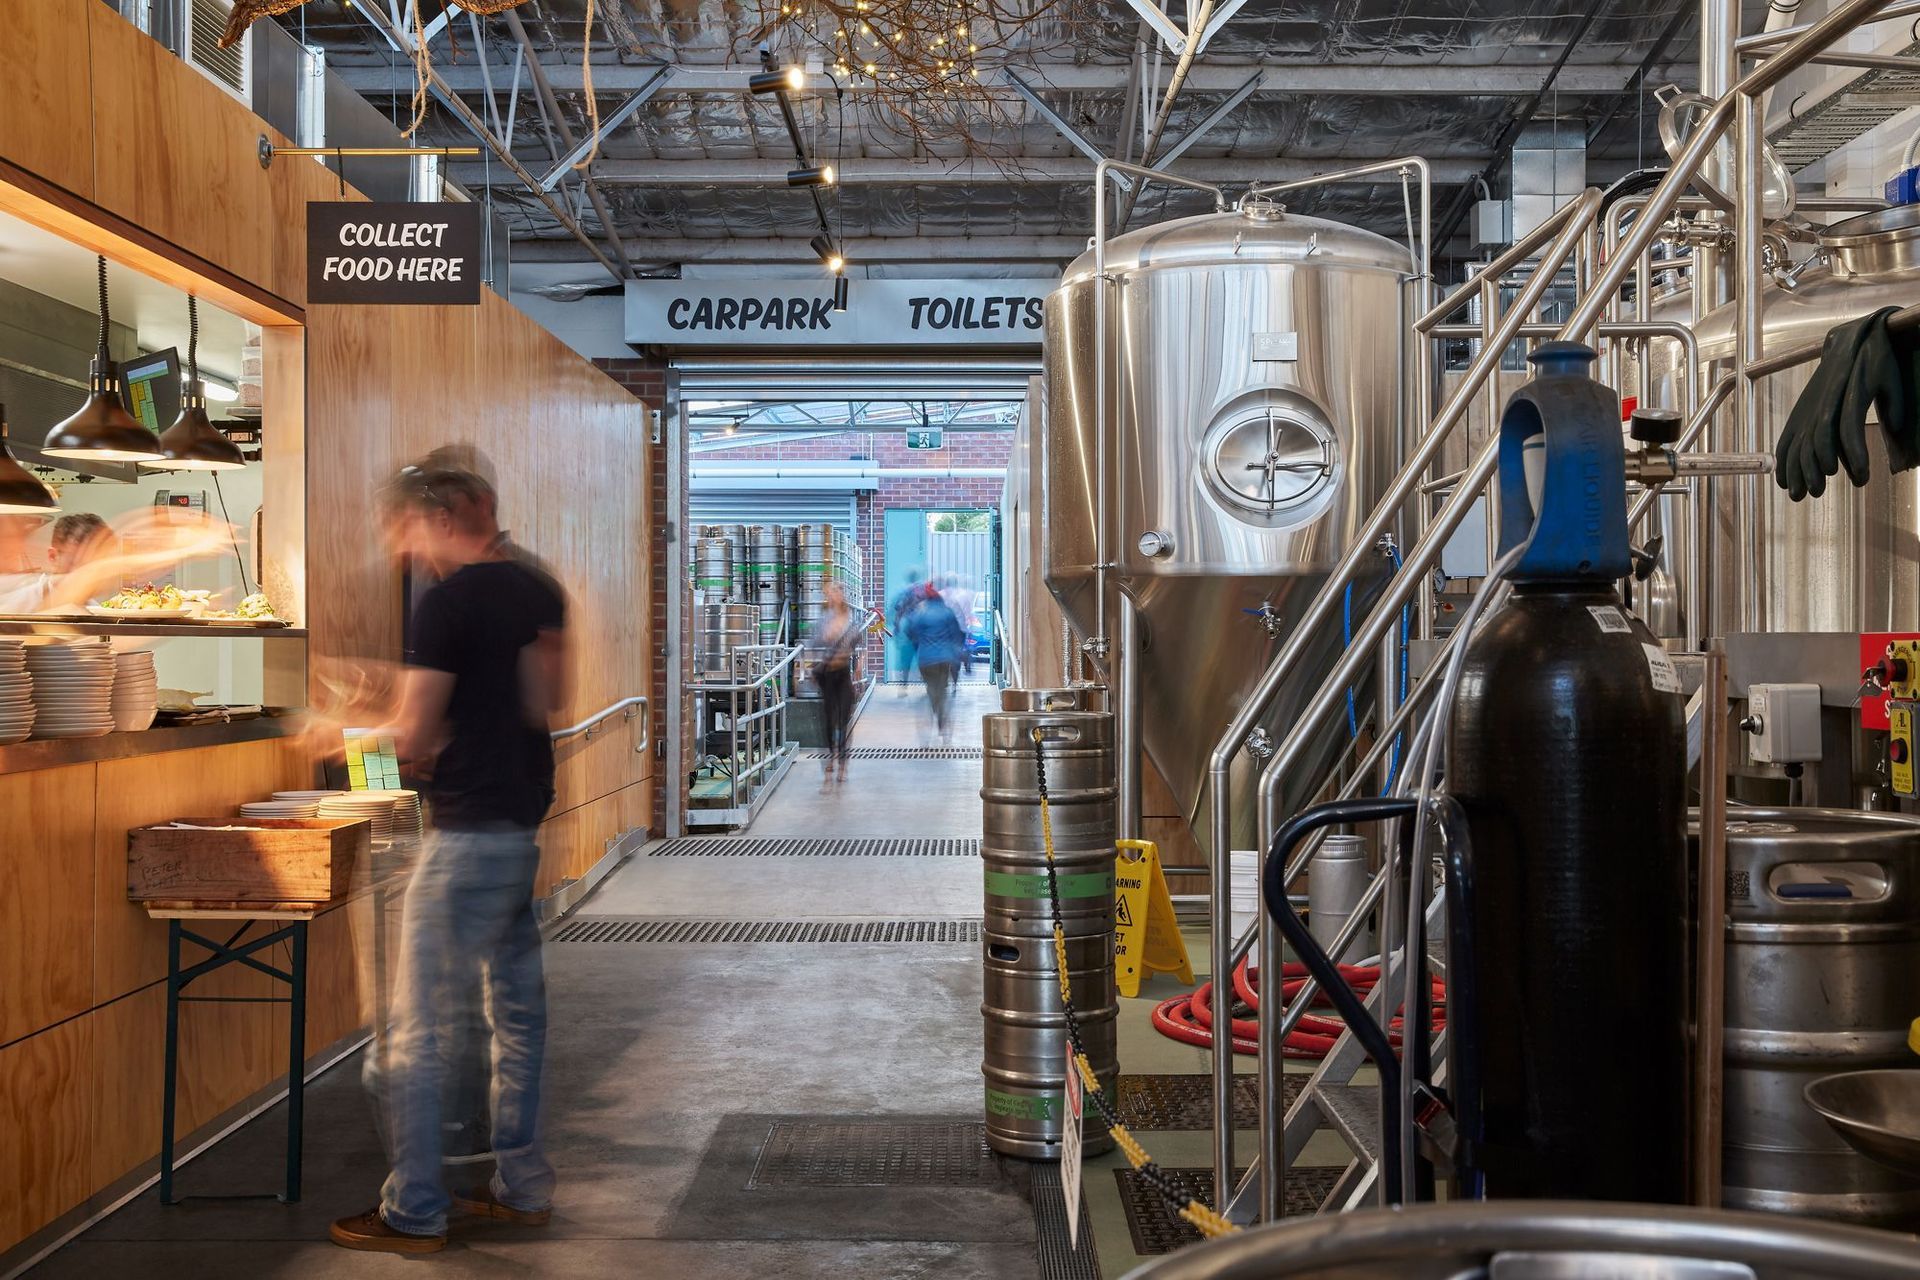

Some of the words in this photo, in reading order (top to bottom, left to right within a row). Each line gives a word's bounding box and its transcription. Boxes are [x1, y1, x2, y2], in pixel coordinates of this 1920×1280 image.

[339, 222, 449, 248] COLLECT
[322, 256, 394, 282] FOOD
[396, 257, 464, 282] HERE
[667, 297, 835, 331] CARPARK
[908, 296, 1044, 330] TOILETS
[1116, 878, 1141, 889] ARNING
[1115, 932, 1125, 943] ET
